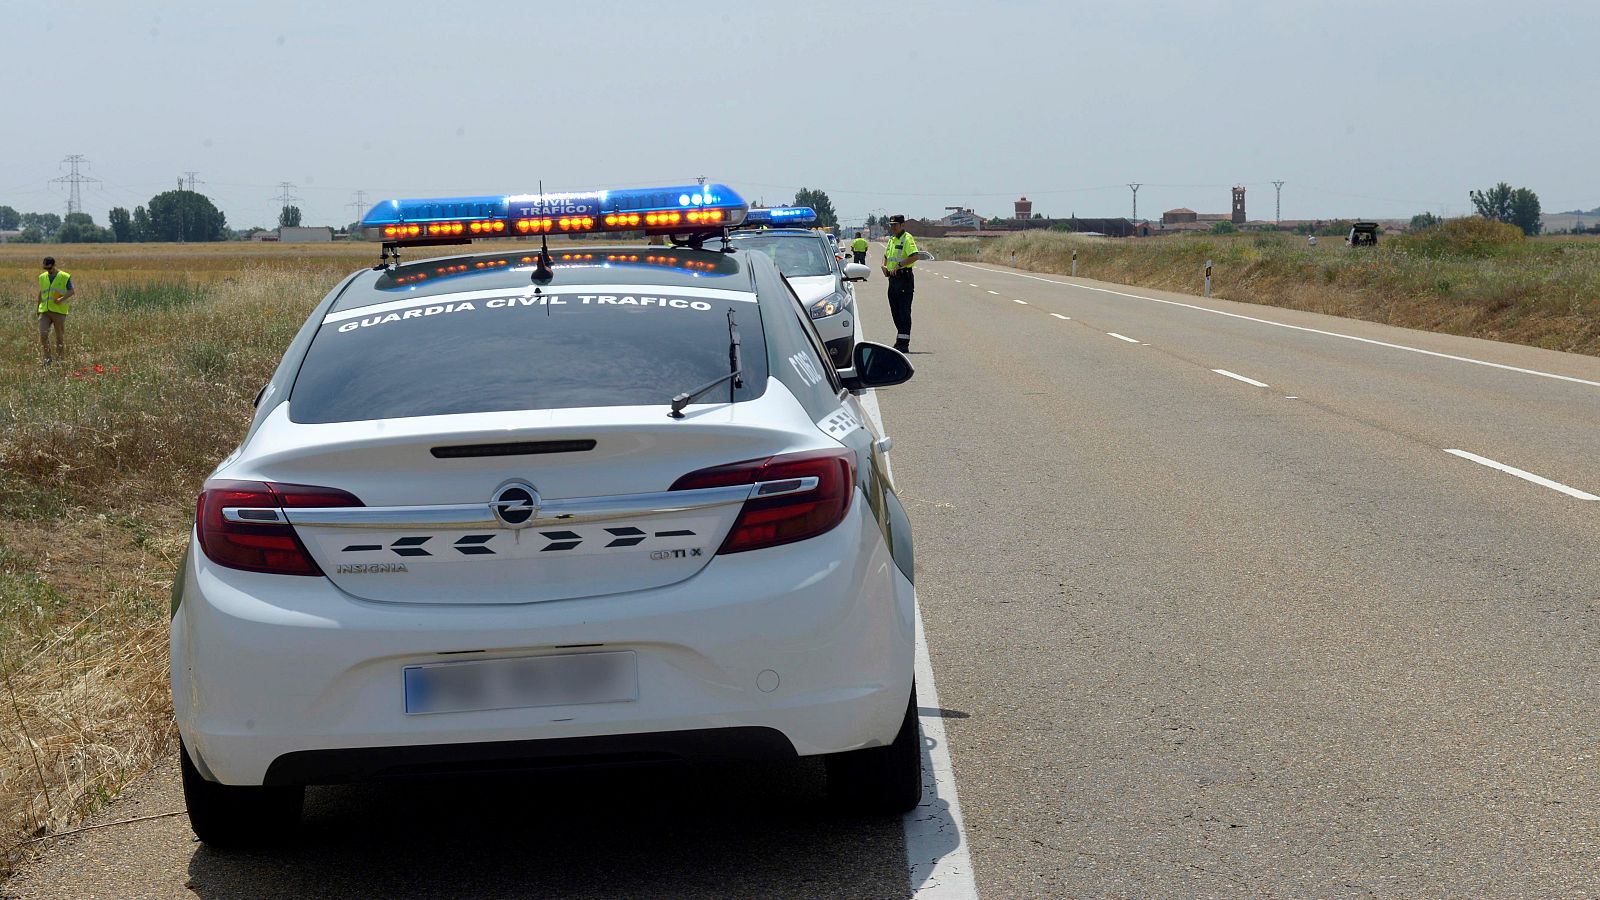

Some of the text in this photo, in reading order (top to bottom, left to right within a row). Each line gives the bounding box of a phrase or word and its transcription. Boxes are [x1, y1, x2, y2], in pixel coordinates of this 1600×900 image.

[533, 198, 575, 207] CIVIL
[520, 205, 587, 216] TRAFICO
[337, 294, 713, 333] GUARDIA CIVIL TRAFICO
[650, 548, 686, 561] CDTI
[335, 562, 409, 575] INSIGNIA
